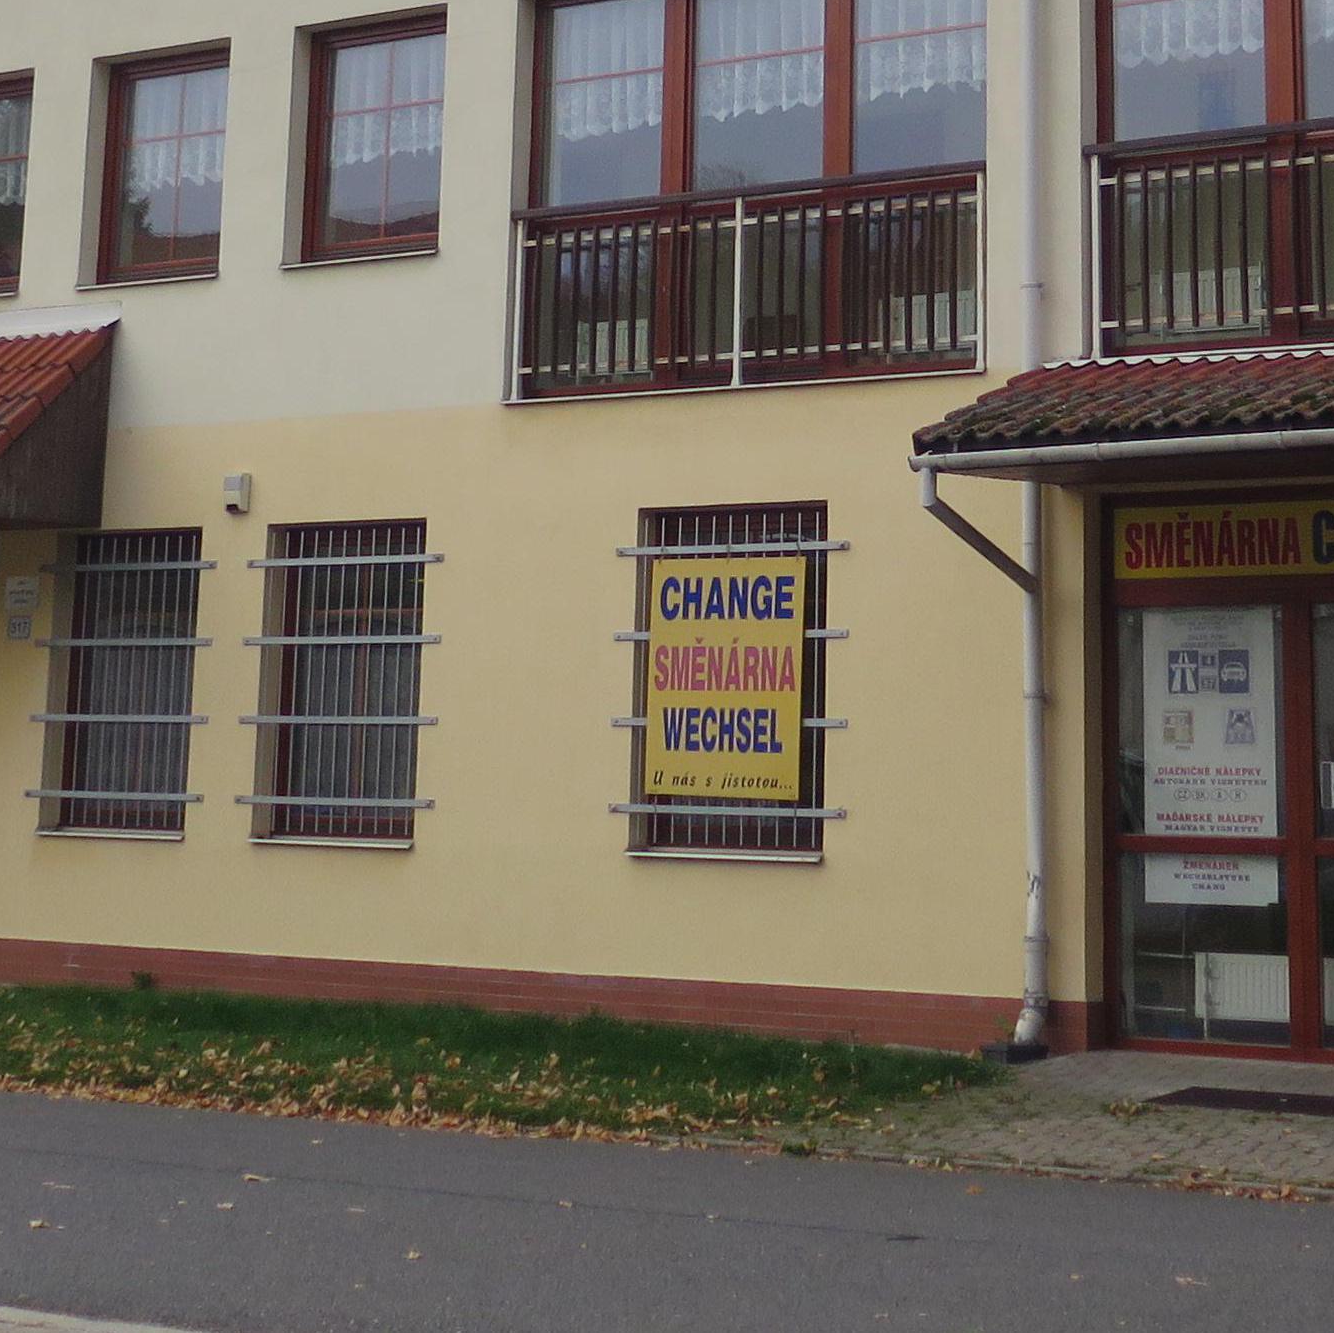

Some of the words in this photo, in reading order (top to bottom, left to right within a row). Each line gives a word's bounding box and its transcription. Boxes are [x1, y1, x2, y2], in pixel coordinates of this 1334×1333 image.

[1124, 511, 1301, 570] SMĚNÁRNA
[660, 575, 795, 620] CHANGE
[654, 637, 796, 692] SMĚNÁRNA
[663, 706, 783, 754] WECHSEL
[653, 771, 663, 786] U
[672, 772, 696, 787] nás
[705, 777, 712, 787] s
